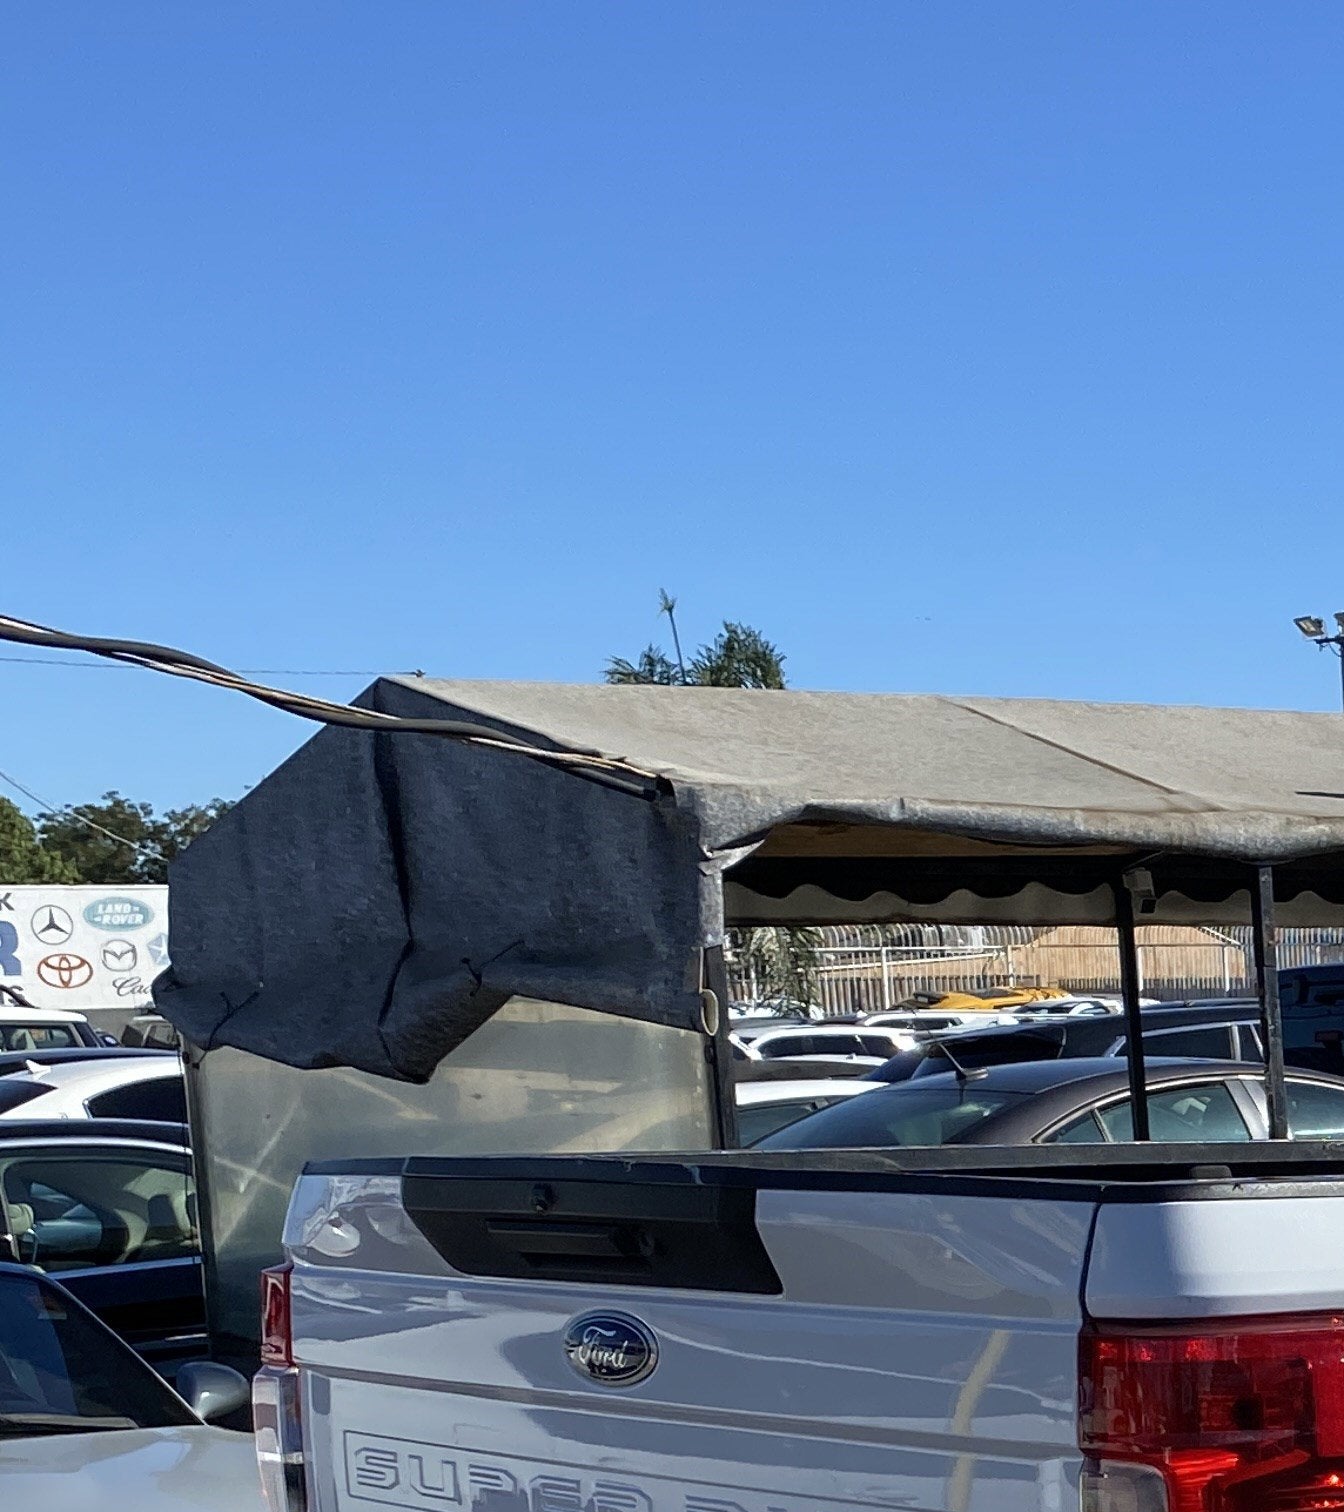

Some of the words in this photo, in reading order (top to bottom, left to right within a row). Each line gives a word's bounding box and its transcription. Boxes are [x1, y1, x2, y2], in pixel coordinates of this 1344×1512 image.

[97, 902, 132, 914] LAND
[101, 912, 144, 925] ROVER
[578, 1325, 629, 1369] Ford
